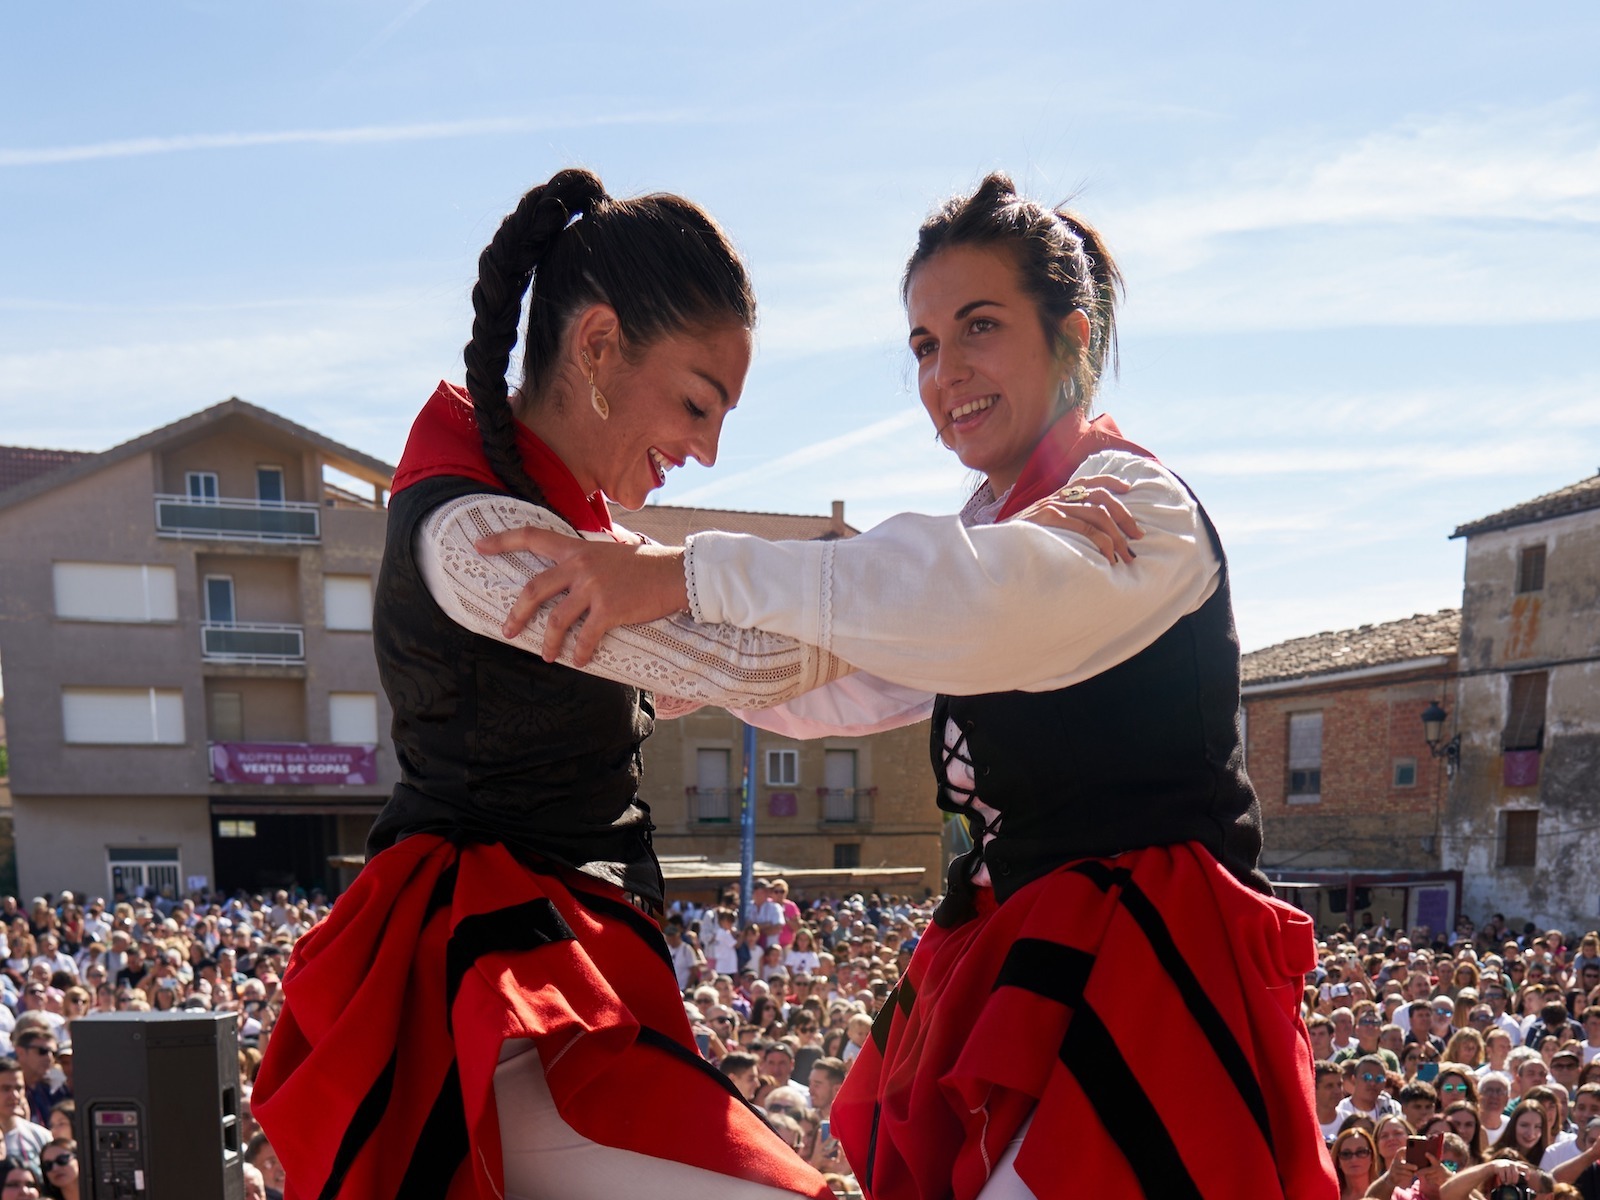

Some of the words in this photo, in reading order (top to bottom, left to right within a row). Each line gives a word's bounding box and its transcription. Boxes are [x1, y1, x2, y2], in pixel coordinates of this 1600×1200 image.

[242, 764, 285, 773] VENTA
[287, 764, 305, 773] DE
[307, 764, 350, 773] COPAS
